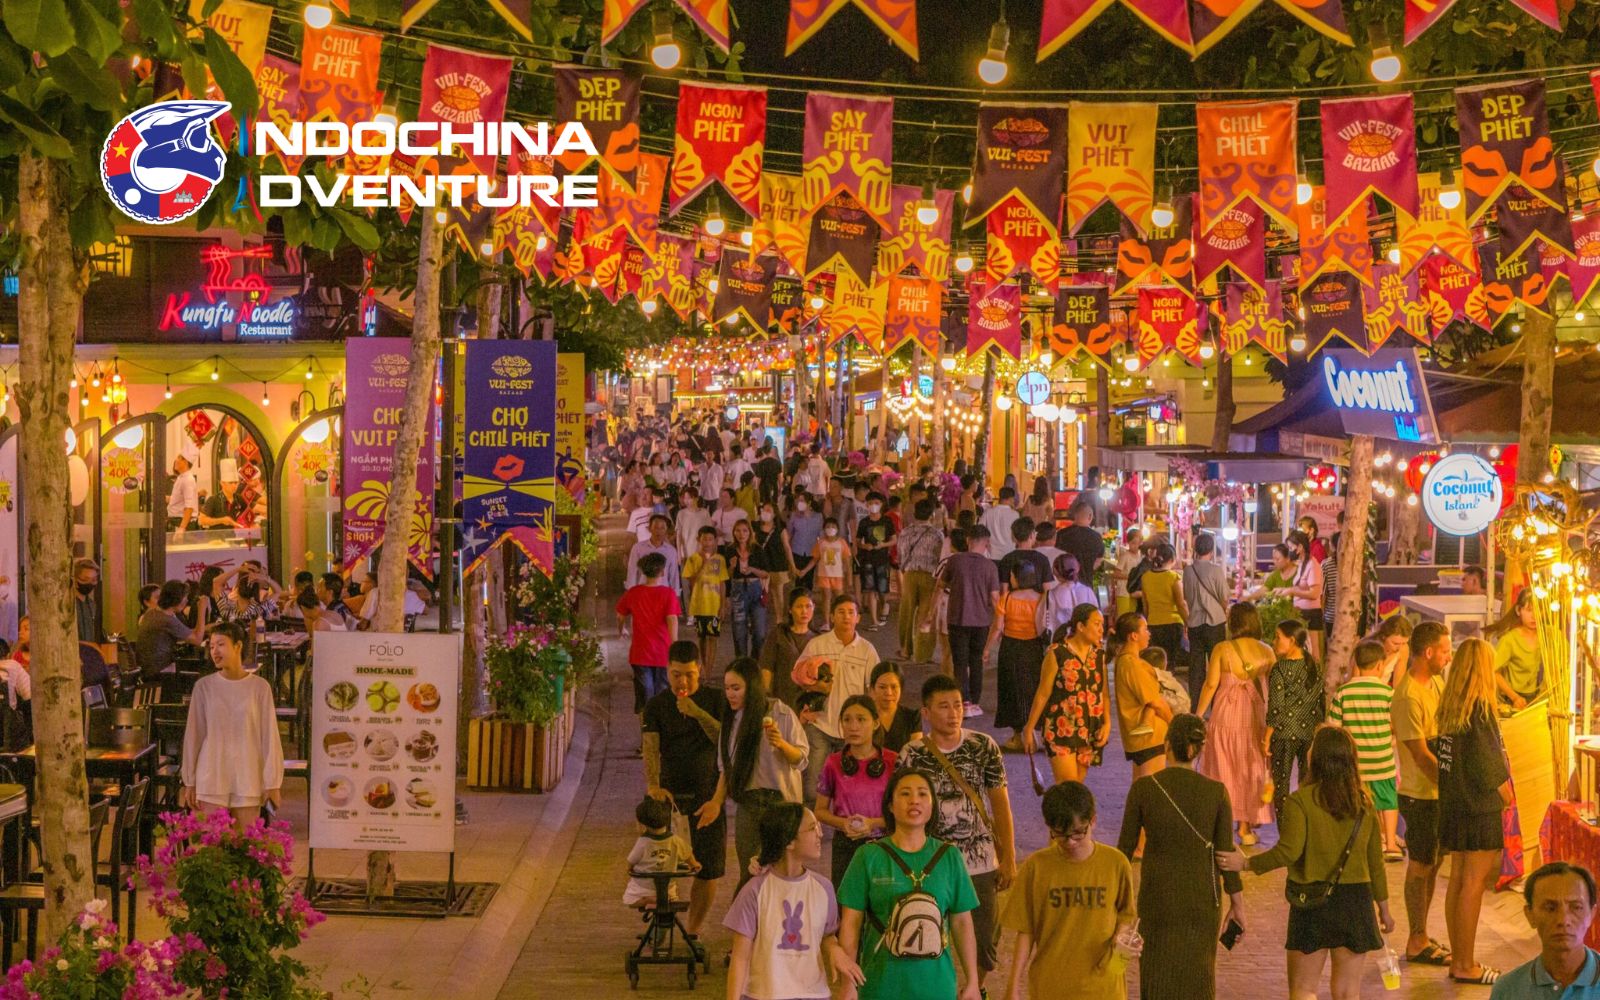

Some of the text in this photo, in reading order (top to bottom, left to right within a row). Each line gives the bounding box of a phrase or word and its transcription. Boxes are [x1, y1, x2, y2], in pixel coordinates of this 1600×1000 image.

[321, 34, 362, 56] CHILL
[431, 102, 483, 124] BAZAAR
[699, 101, 743, 119] NGON
[1481, 94, 1525, 118] ĐẸP
[831, 109, 867, 131] SAY
[1219, 112, 1267, 133] CHILL
[1087, 123, 1128, 144] VUI
[1338, 119, 1403, 141] VUI-FEST
[987, 147, 1051, 163] VUI-FEST
[1342, 151, 1400, 172] BAZAAR
[768, 187, 796, 206] VUI
[659, 242, 680, 256] SAY
[1208, 235, 1250, 250] BAZAAR
[158, 292, 294, 331] Kungfu Noodle
[240, 323, 293, 336] Restaurant
[977, 316, 1012, 331] BAZAAR
[1323, 356, 1415, 413] Coconut
[351, 429, 383, 447] VUI
[469, 428, 508, 447] CHILL
[1433, 480, 1494, 497] Coconut
[1303, 502, 1341, 512] Yakult
[369, 644, 404, 657] FOLO
[356, 666, 414, 676] HOME-MADE
[1049, 886, 1107, 909] STATE
